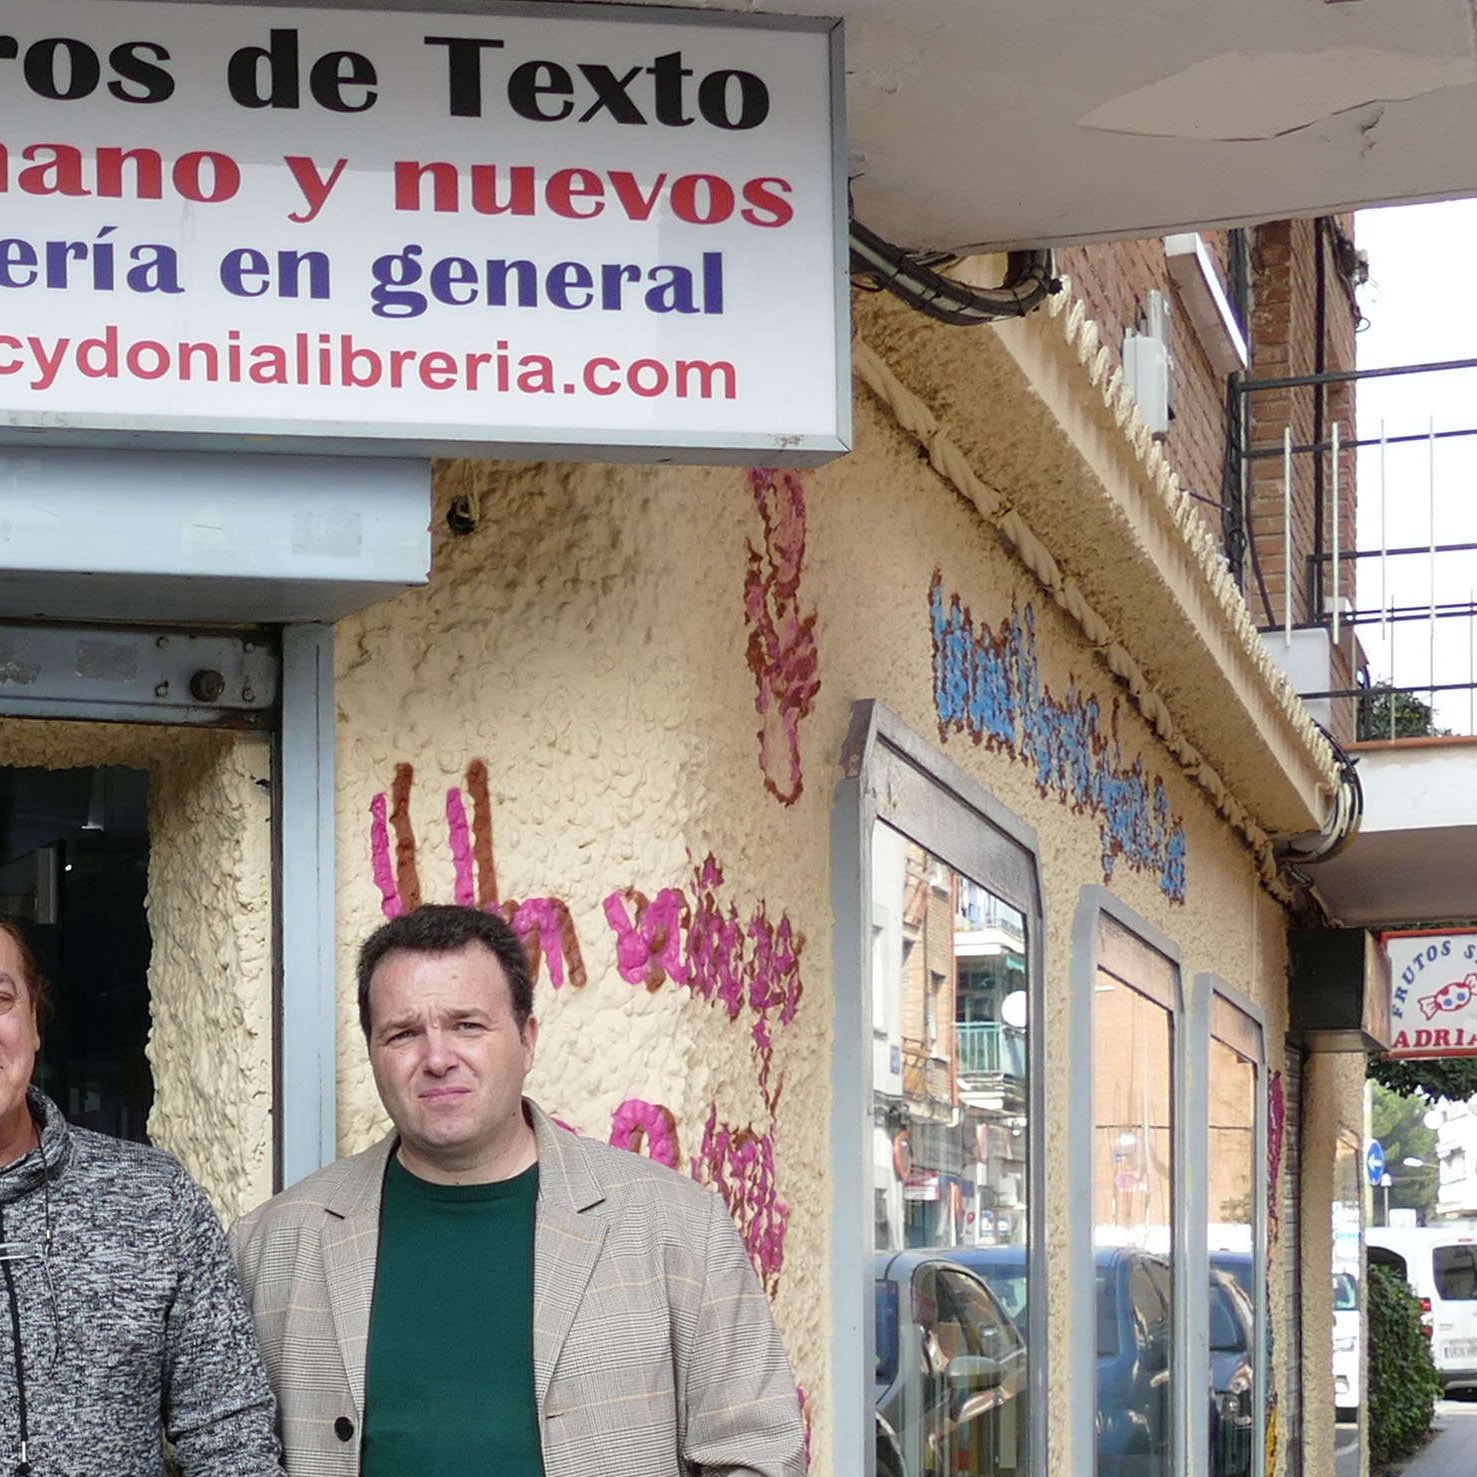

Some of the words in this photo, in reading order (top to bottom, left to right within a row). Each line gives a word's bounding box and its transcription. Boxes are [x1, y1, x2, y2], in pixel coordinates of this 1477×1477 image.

[227, 28, 379, 113] de
[423, 36, 771, 131] Texto
[283, 155, 349, 224] y
[393, 160, 795, 229] nuevos
[219, 244, 331, 300] en
[370, 244, 725, 319] general
[1392, 939, 1452, 1020] FRUTOS
